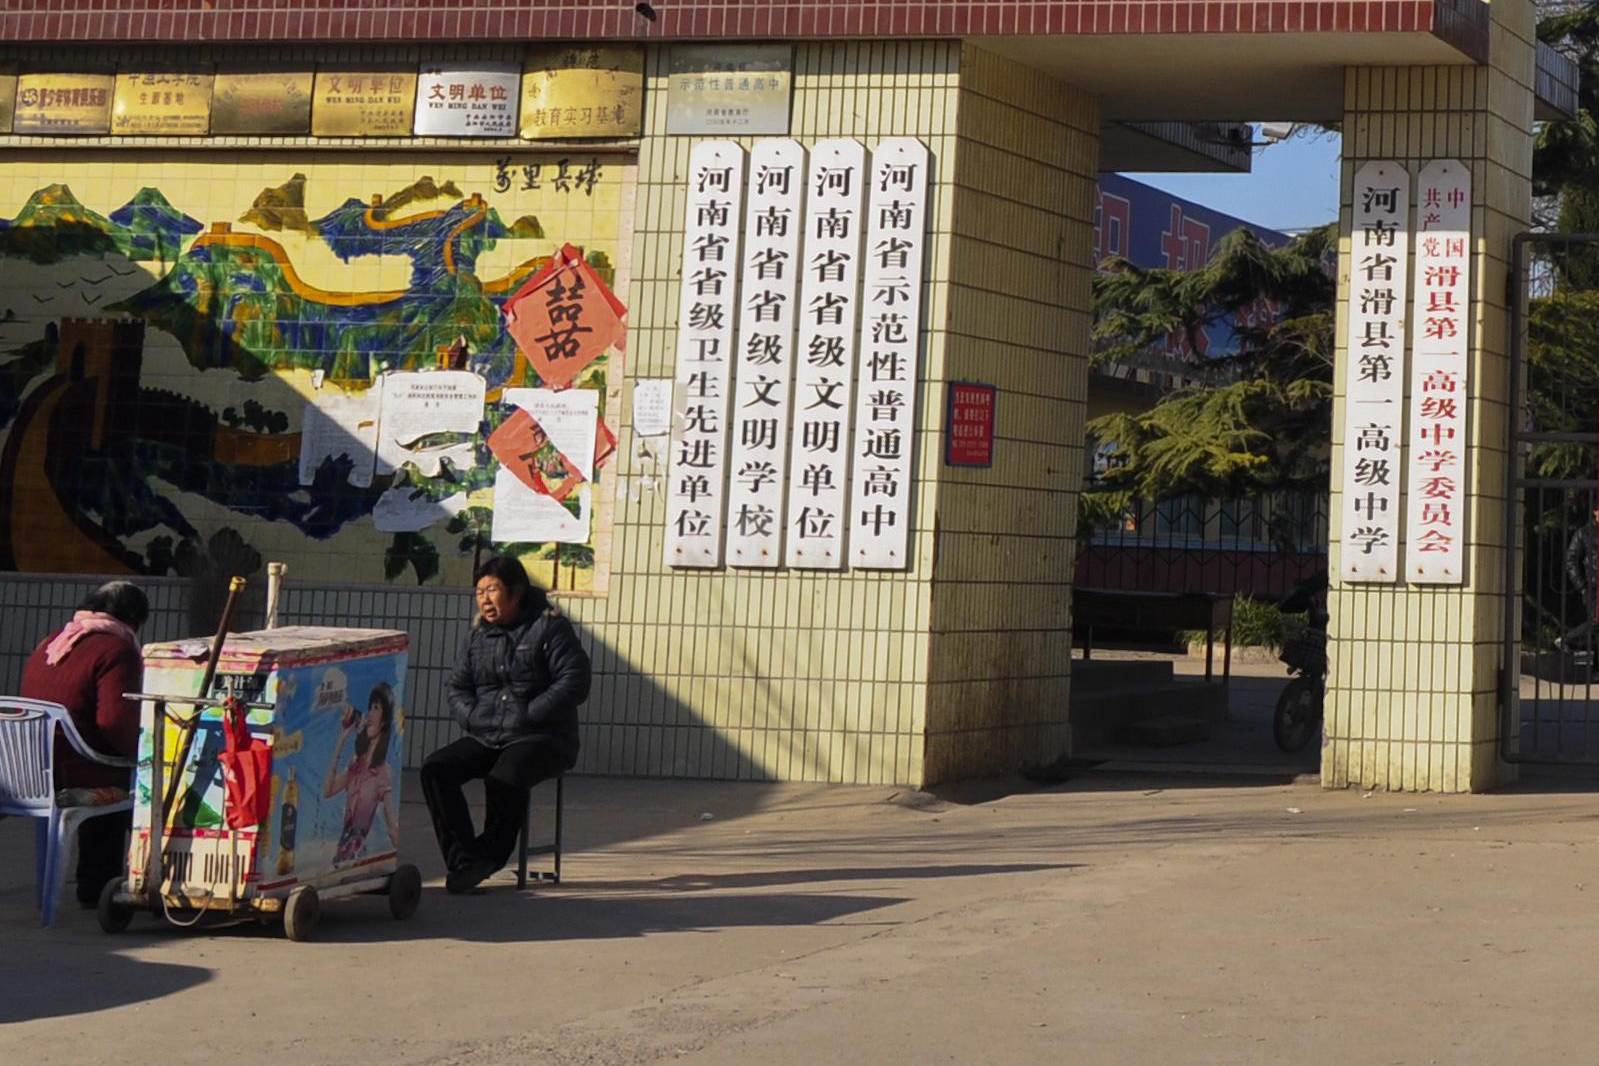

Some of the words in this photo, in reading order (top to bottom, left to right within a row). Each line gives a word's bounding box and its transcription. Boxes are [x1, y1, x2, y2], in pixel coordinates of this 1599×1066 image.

[328, 77, 402, 94] 文明单位
[428, 84, 508, 102] 文明单位
[535, 104, 626, 127] 教育实习基地
[679, 77, 780, 91] 示范性普通高中
[673, 165, 734, 537] 河南省省级卫生先进单位
[734, 164, 795, 538] 河南省省级文明学校
[794, 165, 855, 539] 河南省省级文明单位
[860, 162, 918, 537] 河南省示范性普通高中
[1350, 186, 1401, 554] 河南省滑县第一高级中学
